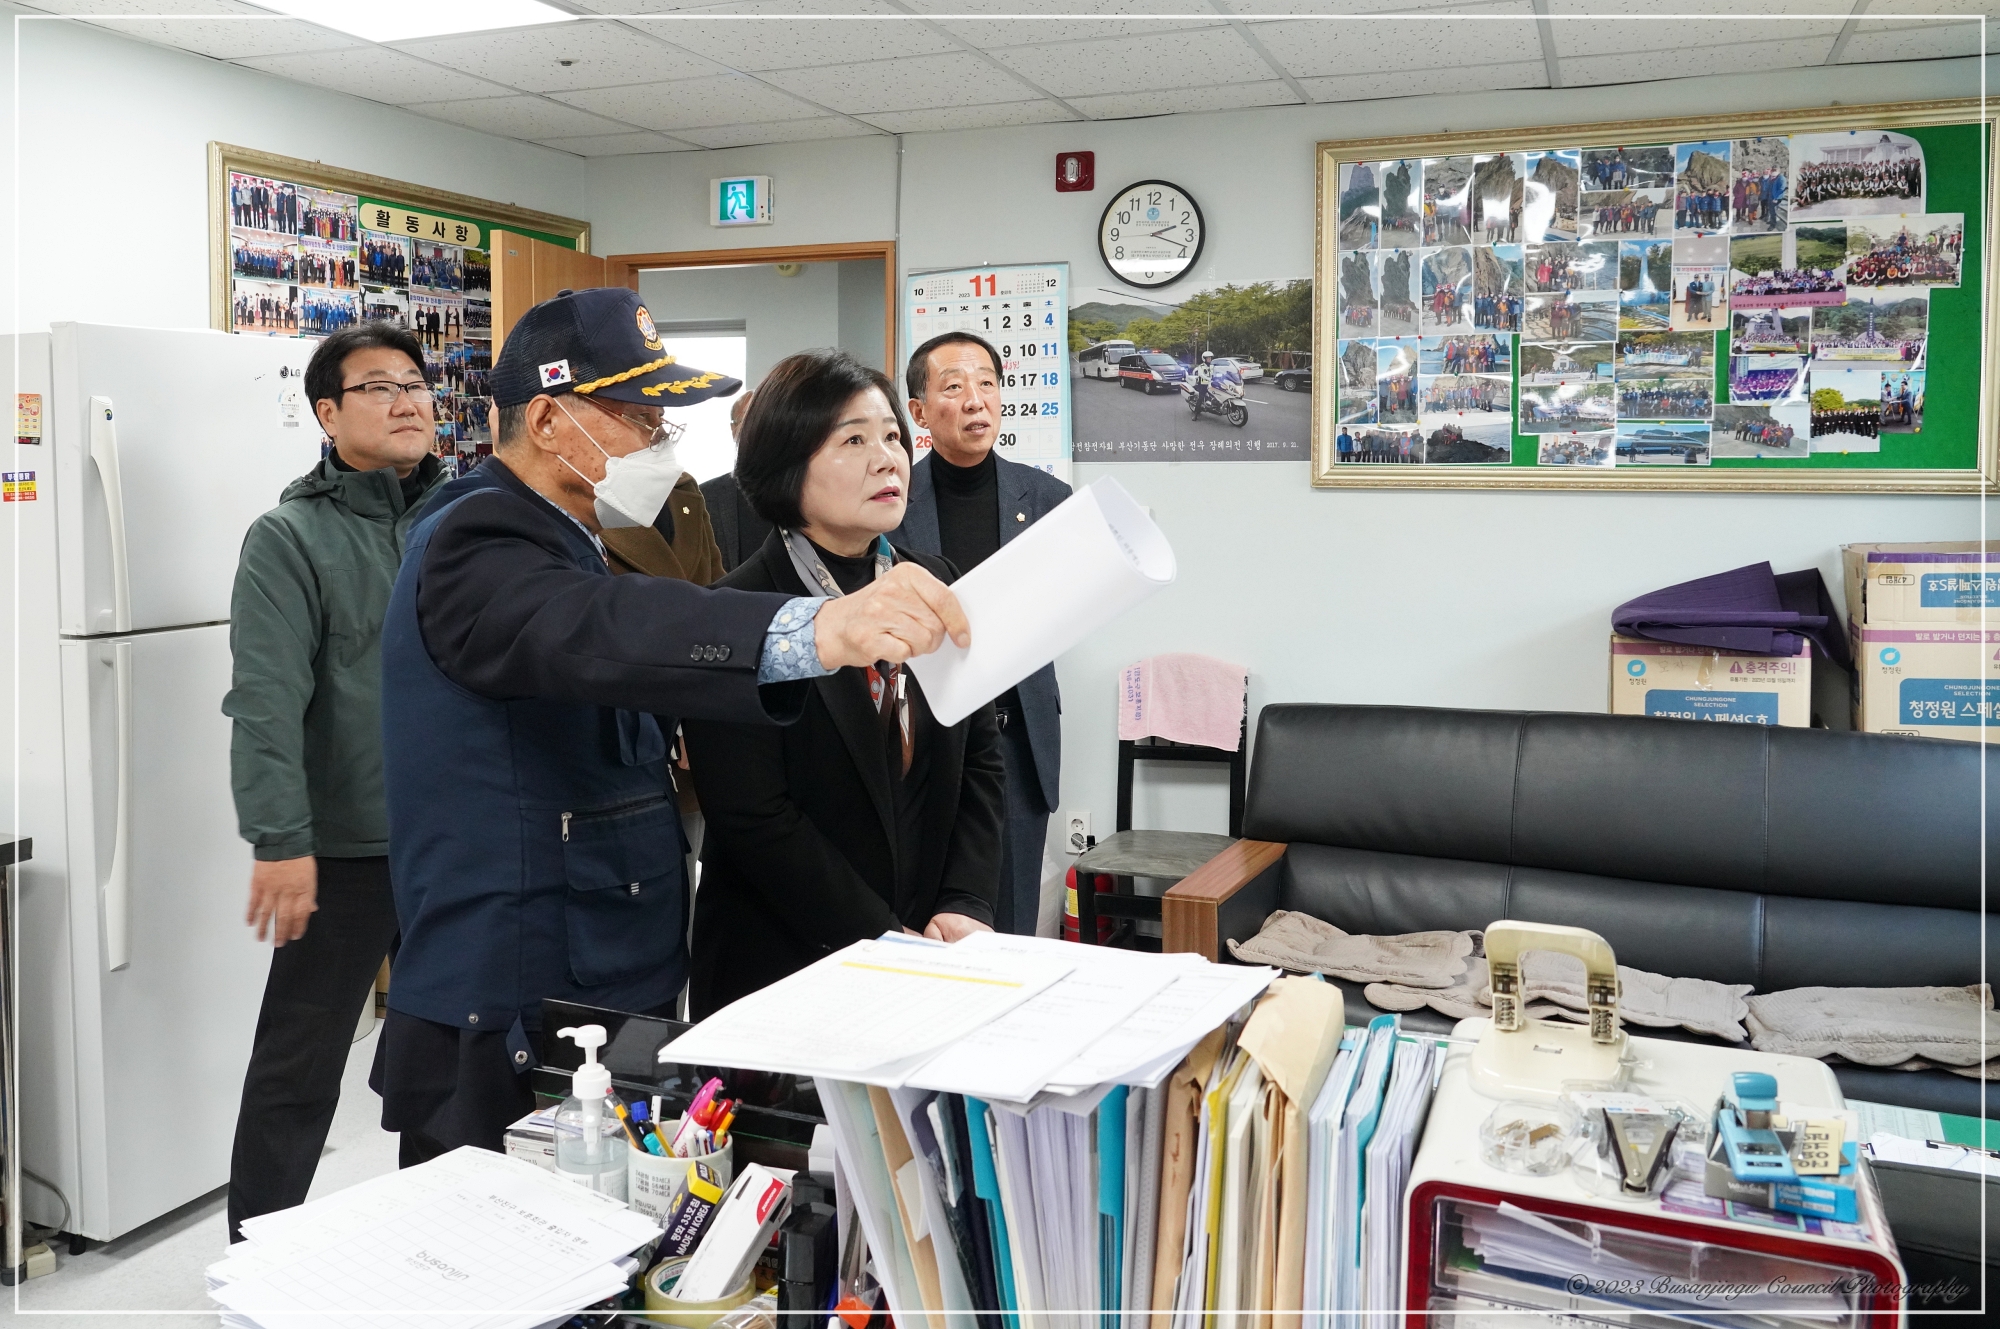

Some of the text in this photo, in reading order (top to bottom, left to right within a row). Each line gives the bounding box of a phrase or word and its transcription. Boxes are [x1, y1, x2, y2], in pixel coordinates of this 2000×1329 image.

[1130, 198, 1140, 211] 11
[1147, 192, 1162, 205] 12
[1169, 198, 1175, 211] 1
[1117, 211, 1131, 224] 10
[1181, 211, 1190, 225] 2
[376, 209, 468, 242] 활동사항
[1110, 228, 1120, 241] 9
[1185, 229, 1194, 242] 3
[1115, 246, 1124, 259] 8
[1177, 247, 1187, 258] 4
[970, 274, 996, 297] 11
[1046, 279, 1056, 287] 12
[914, 288, 924, 296] 10
[983, 317, 989, 329] 1
[1002, 316, 1011, 329] 2
[1023, 314, 1032, 327] 3
[1045, 313, 1053, 326] 4
[1003, 343, 1057, 358] 9 10 11
[290, 369, 300, 377] LG
[1001, 372, 1058, 387] 16 17 18
[1001, 402, 1059, 417] 23 24 25
[915, 436, 932, 449] 26
[999, 433, 1016, 446] 30
[1118, 441, 1157, 451] 부산기동단
[1161, 440, 1185, 451] 사망한
[1190, 441, 1205, 451] 전우
[1209, 440, 1241, 451] 장례의전
[1246, 440, 1261, 451] 진행
[1886, 576, 1908, 584] 4개입
[1958, 633, 1981, 641] 던지는
[1746, 661, 1796, 675] 충격주의!
[1629, 678, 1647, 686] 청정원
[1909, 700, 1956, 719] 청정원
[670, 1198, 701, 1242] 평화 33호침
[676, 1204, 711, 1255] MADE IN KOREA
[416, 1250, 469, 1281] busanjin
